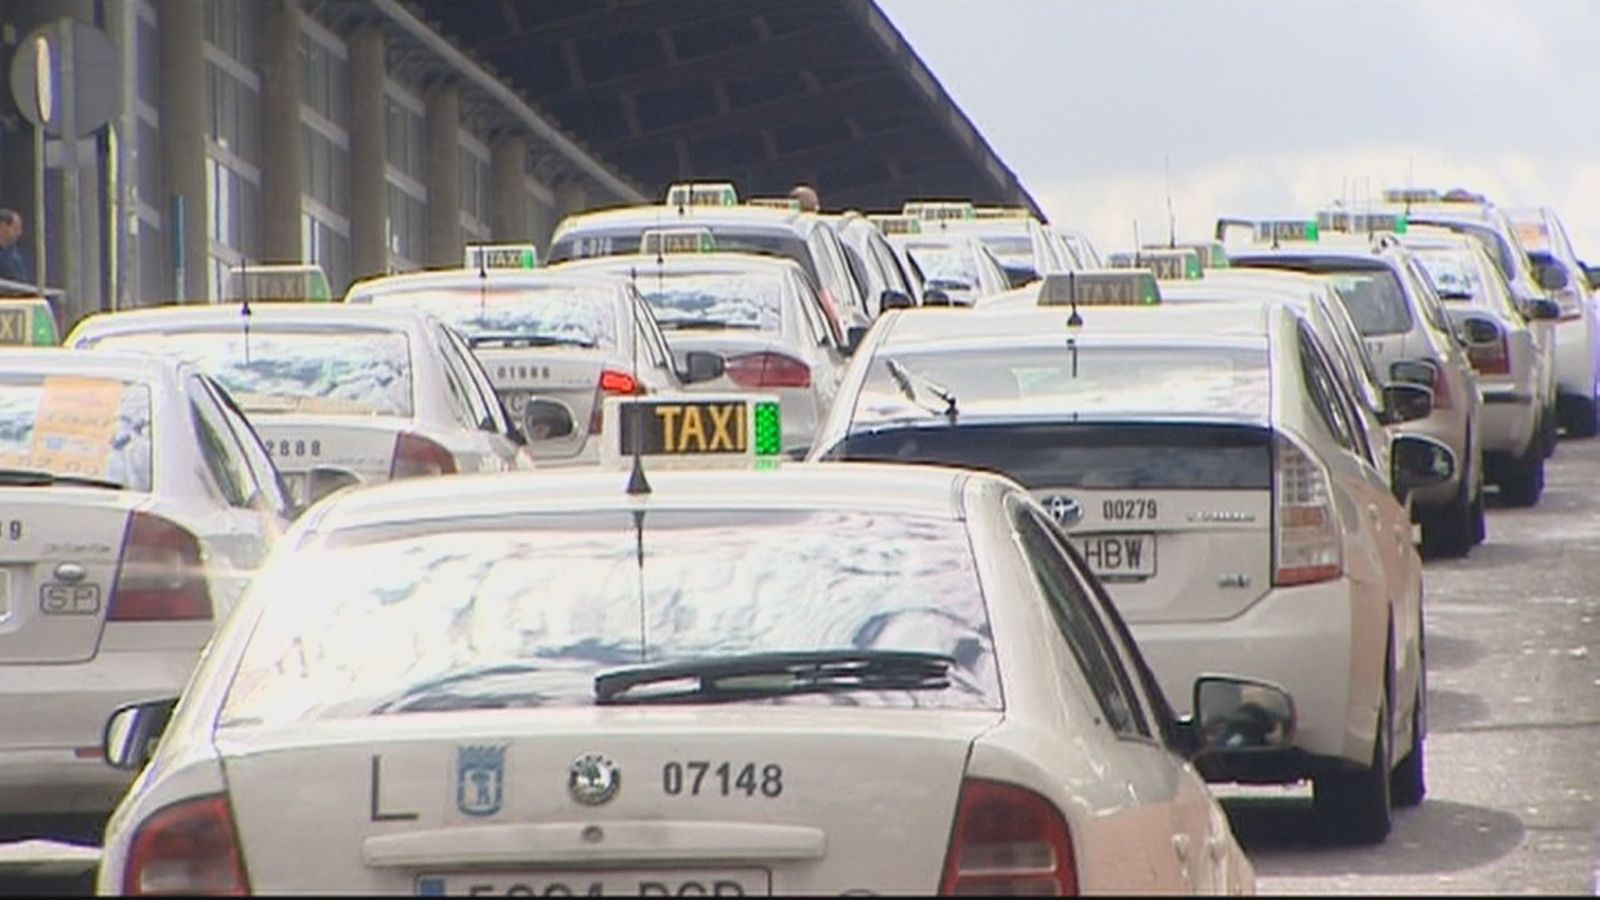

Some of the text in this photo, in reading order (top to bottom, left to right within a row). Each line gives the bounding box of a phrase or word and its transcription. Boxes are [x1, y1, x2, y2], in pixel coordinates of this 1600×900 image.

[1078, 283, 1131, 304] TAXI
[655, 404, 745, 452] TAXI
[1102, 499, 1158, 520] 00279
[1083, 537, 1143, 570] HBW
[370, 754, 418, 821] L
[662, 762, 783, 798] 07148
